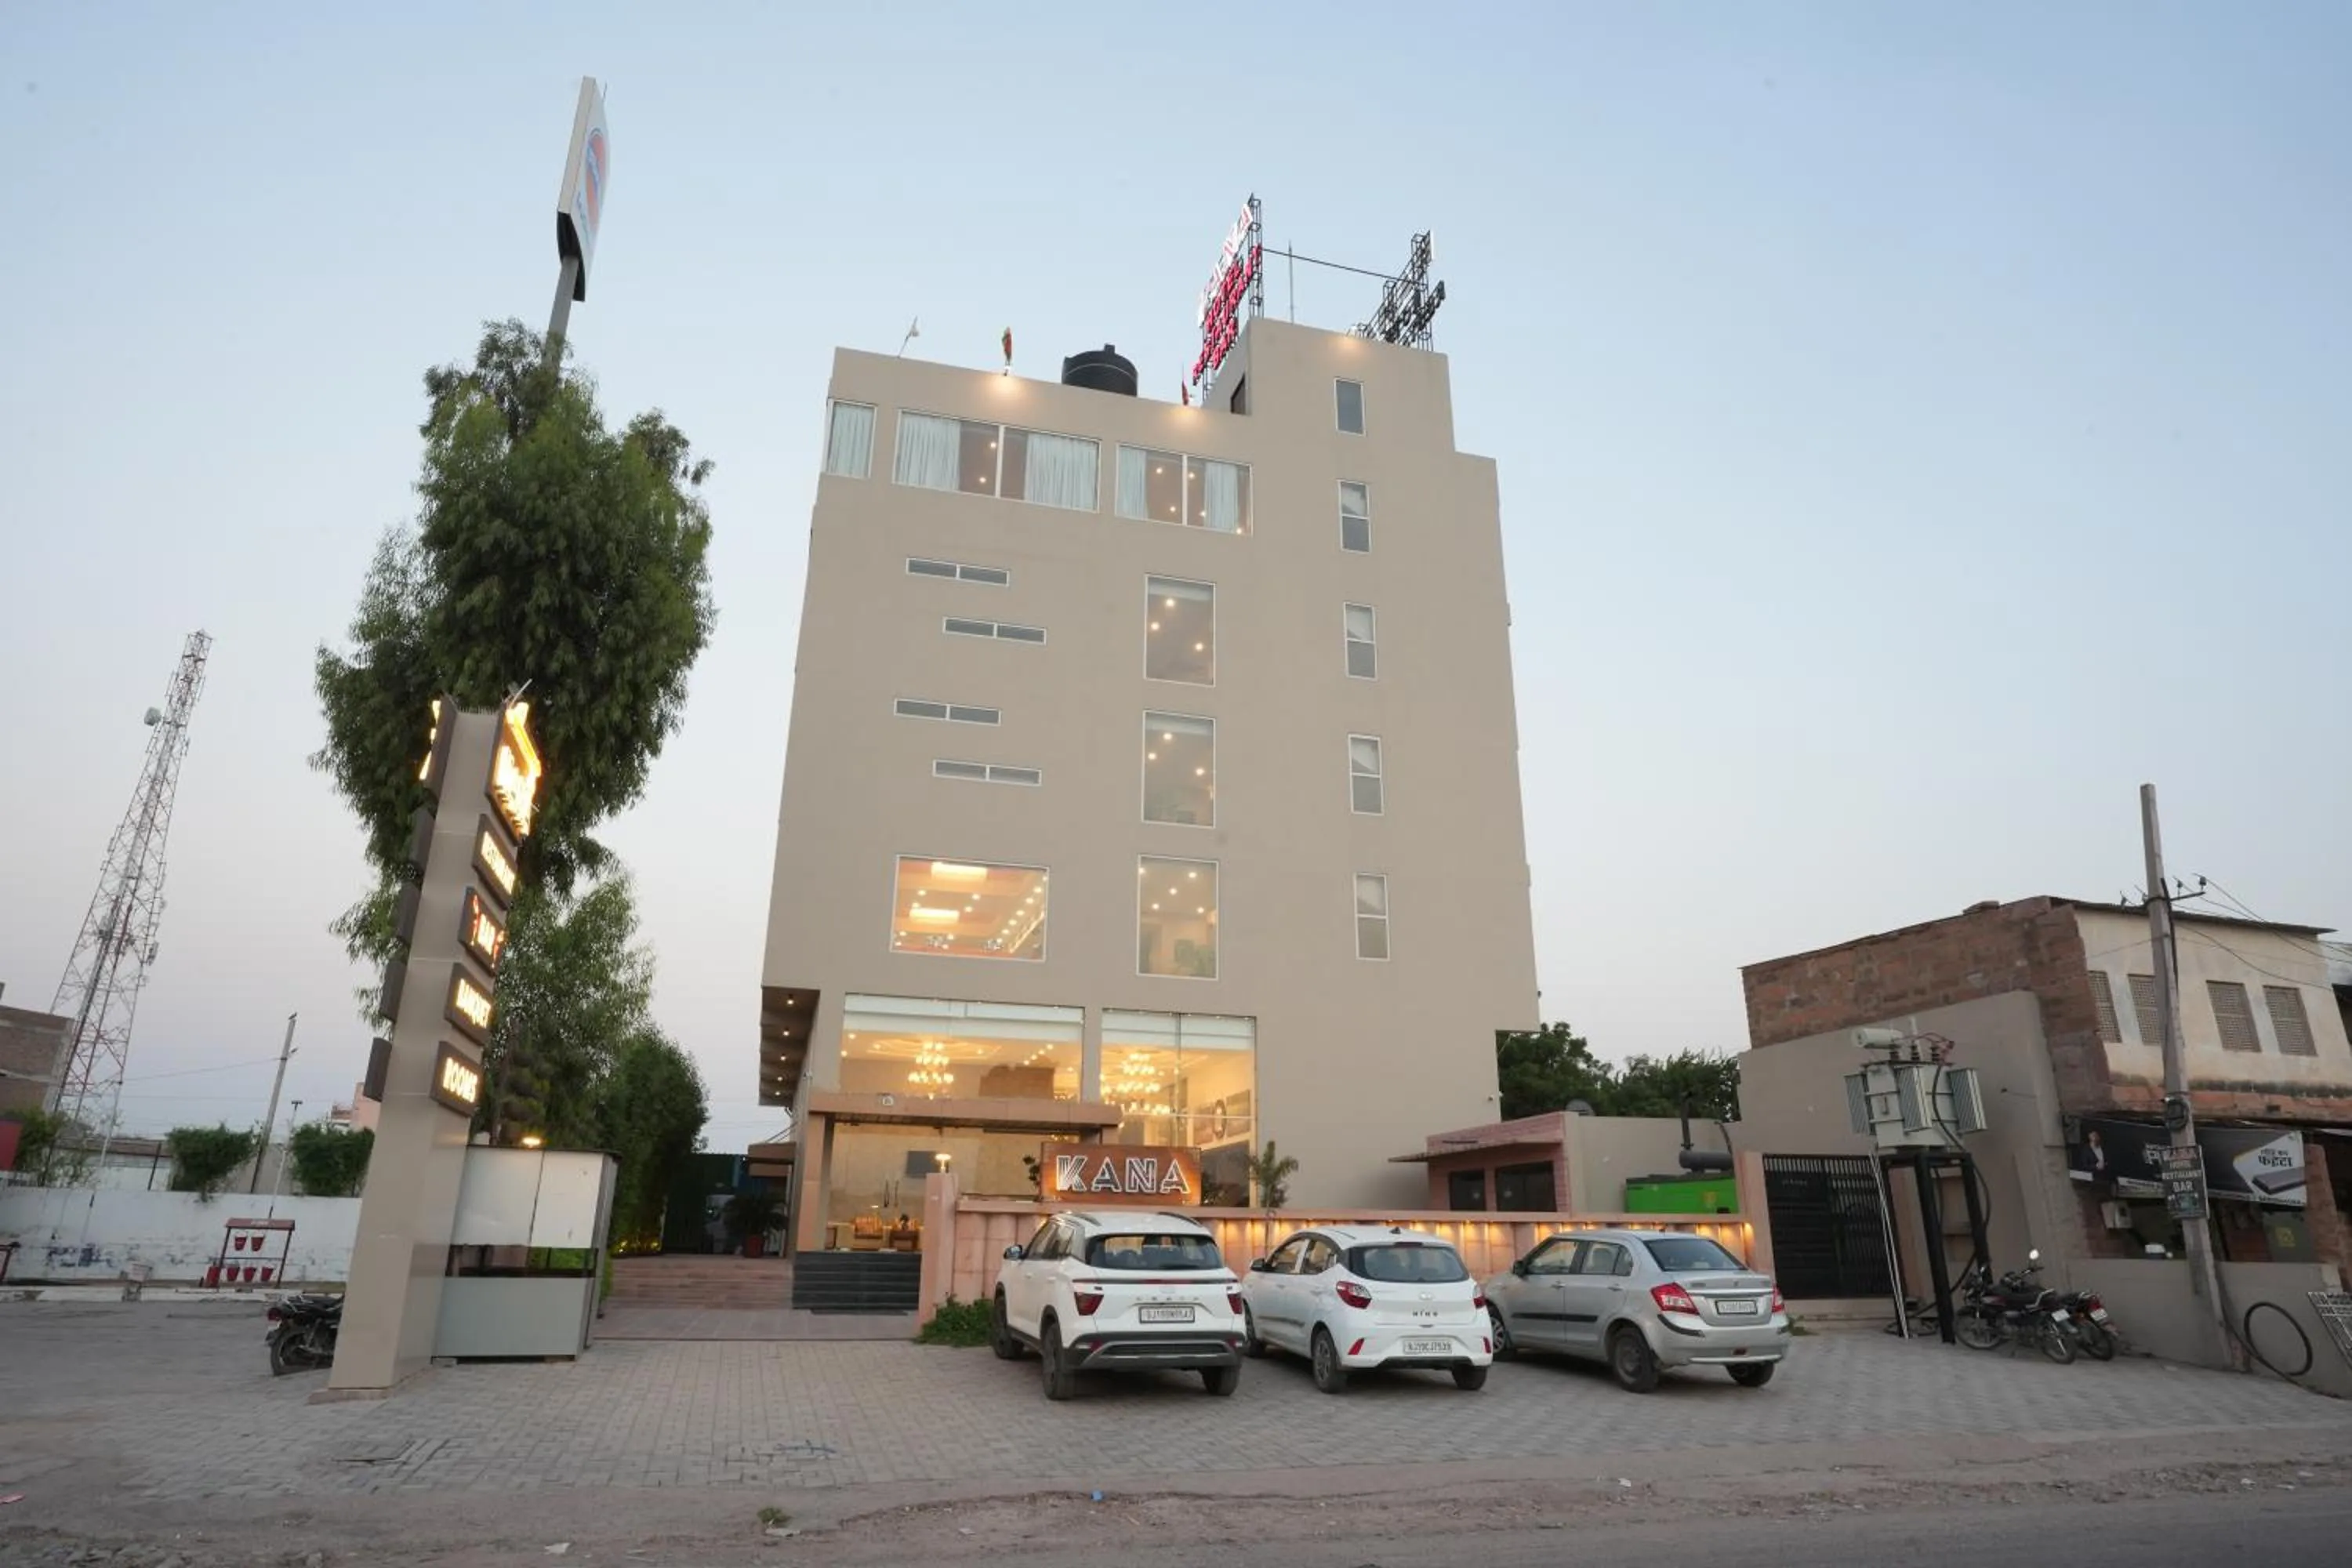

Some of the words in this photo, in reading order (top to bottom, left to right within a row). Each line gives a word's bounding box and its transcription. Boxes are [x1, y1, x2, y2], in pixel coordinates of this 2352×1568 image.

[477, 913, 496, 956] BAR
[456, 978, 492, 1029] BANQUET
[442, 1056, 478, 1103] ROOMS
[1056, 1155, 1191, 1194] KANA
[2172, 1181, 2194, 1192] BAR
